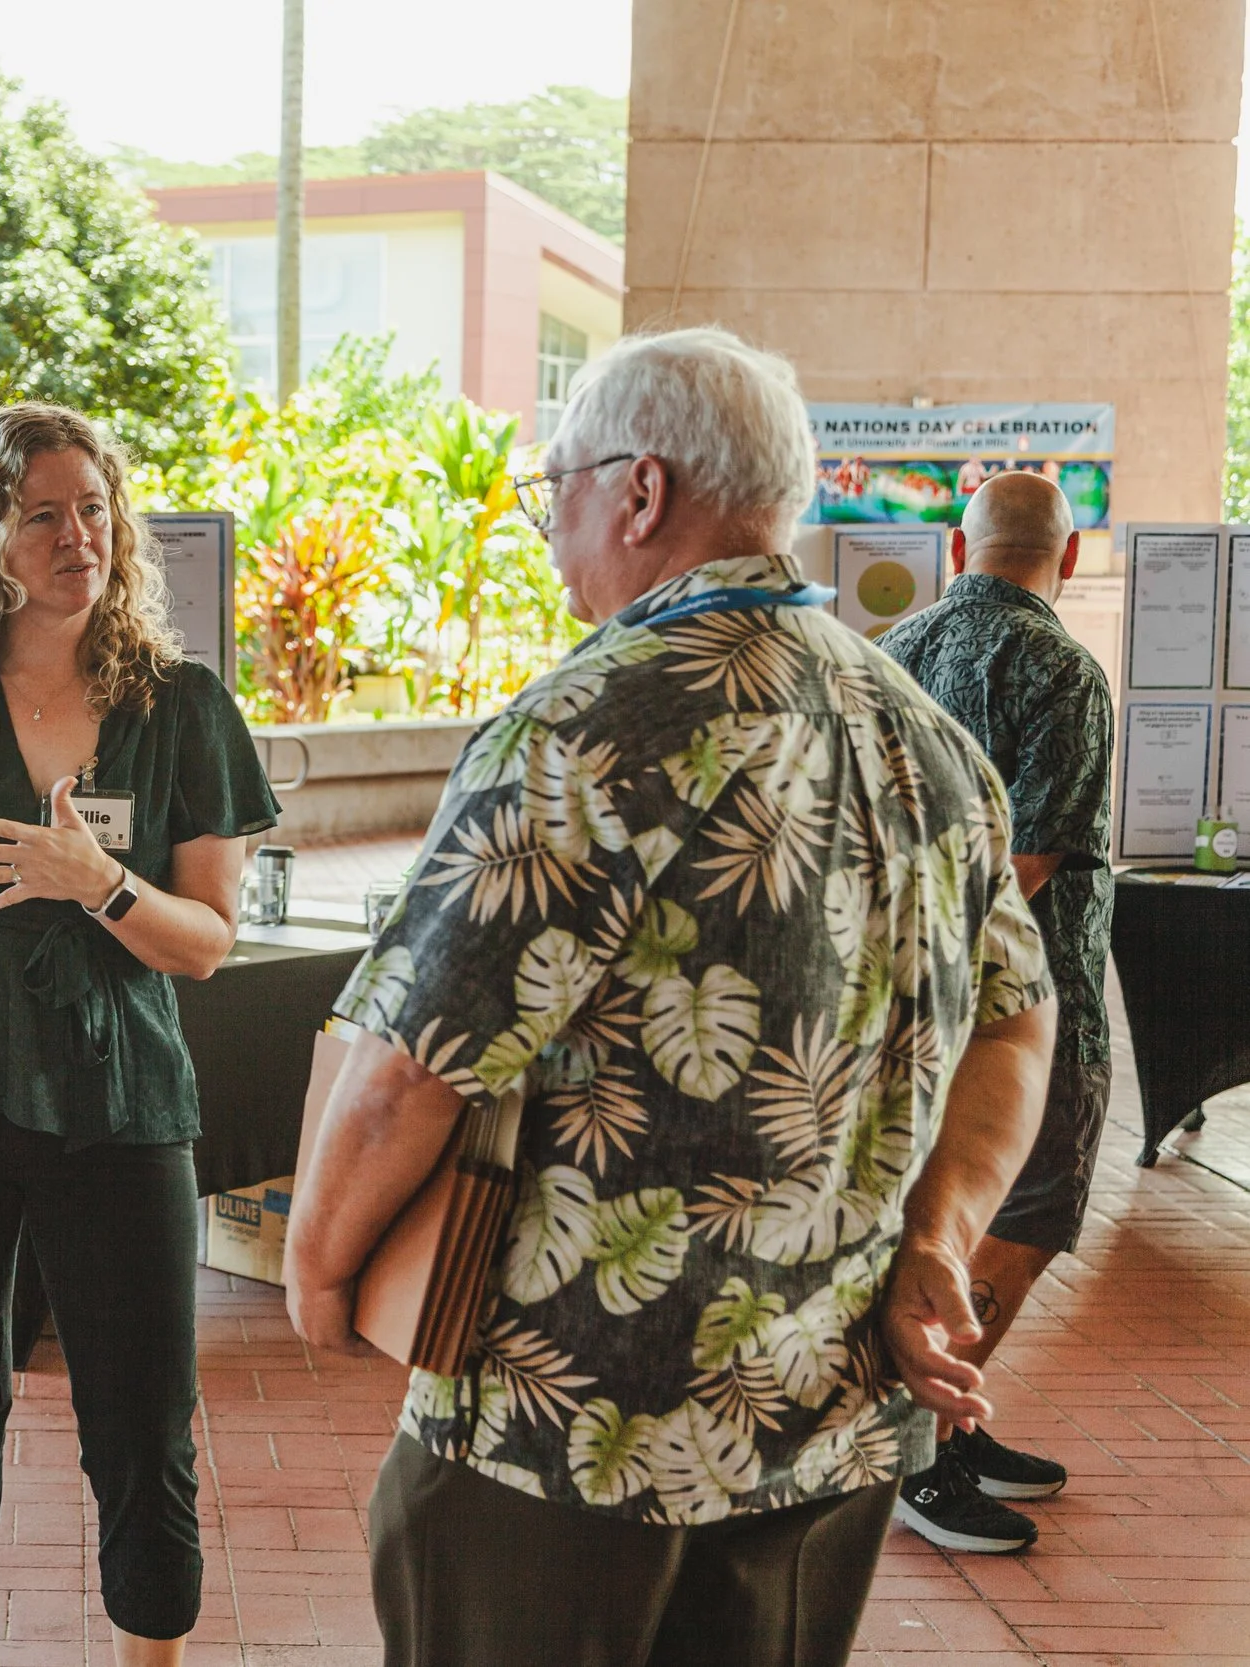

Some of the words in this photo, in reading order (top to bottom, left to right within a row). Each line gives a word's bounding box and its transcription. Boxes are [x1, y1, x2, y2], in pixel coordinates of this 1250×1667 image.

[825, 420, 910, 433] NATIONS
[918, 420, 956, 433] DAY
[962, 420, 1098, 434] CELEBRATION
[218, 1195, 259, 1222] ULINE
